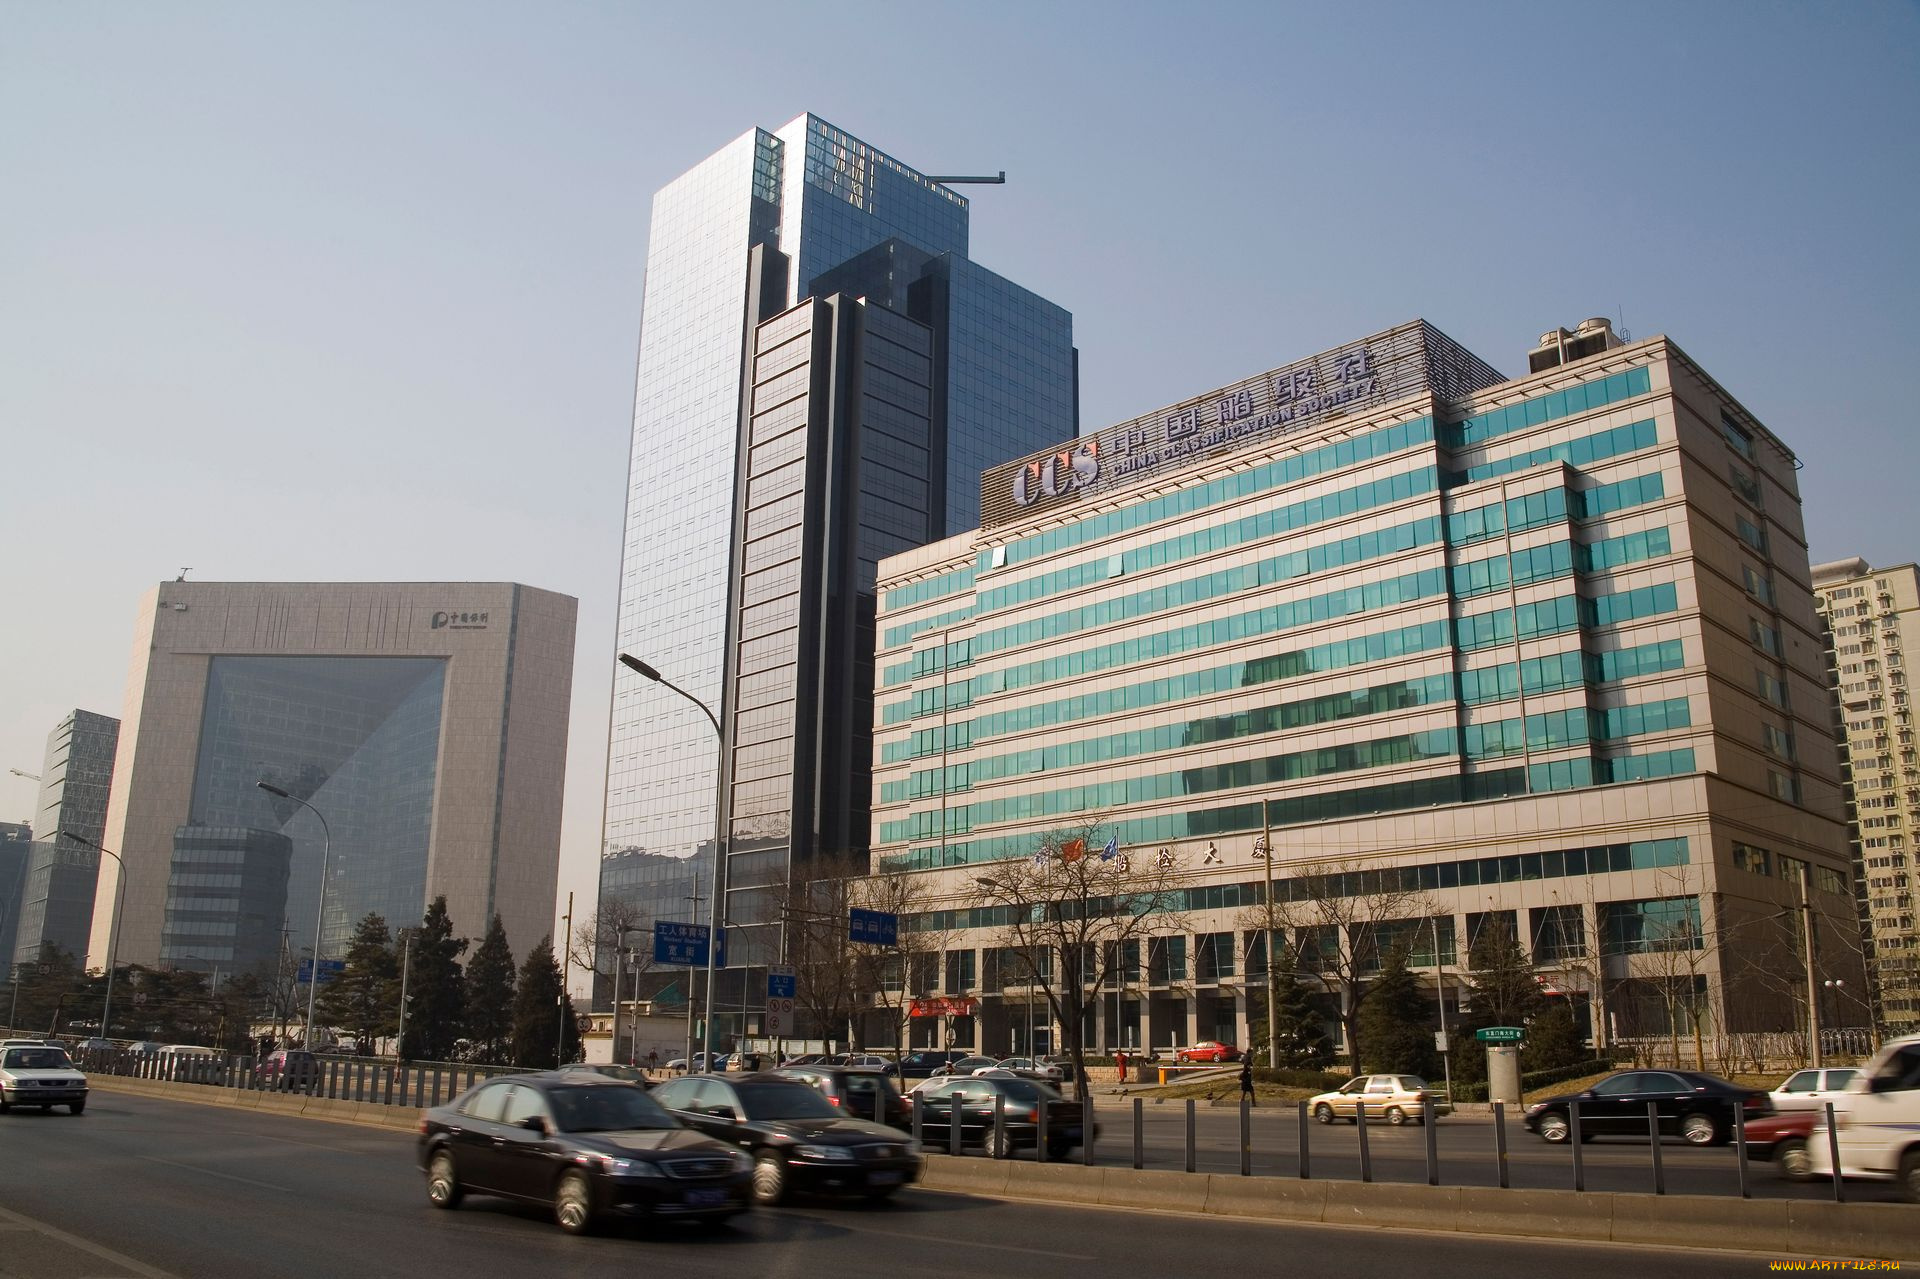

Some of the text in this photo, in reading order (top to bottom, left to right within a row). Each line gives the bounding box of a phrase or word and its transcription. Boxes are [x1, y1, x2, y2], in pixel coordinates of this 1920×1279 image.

[1111, 349, 1376, 456] 中国船级社
[1112, 377, 1376, 476] CHINA CLASSIFICATION SOCIETY
[1012, 441, 1099, 506] CCS
